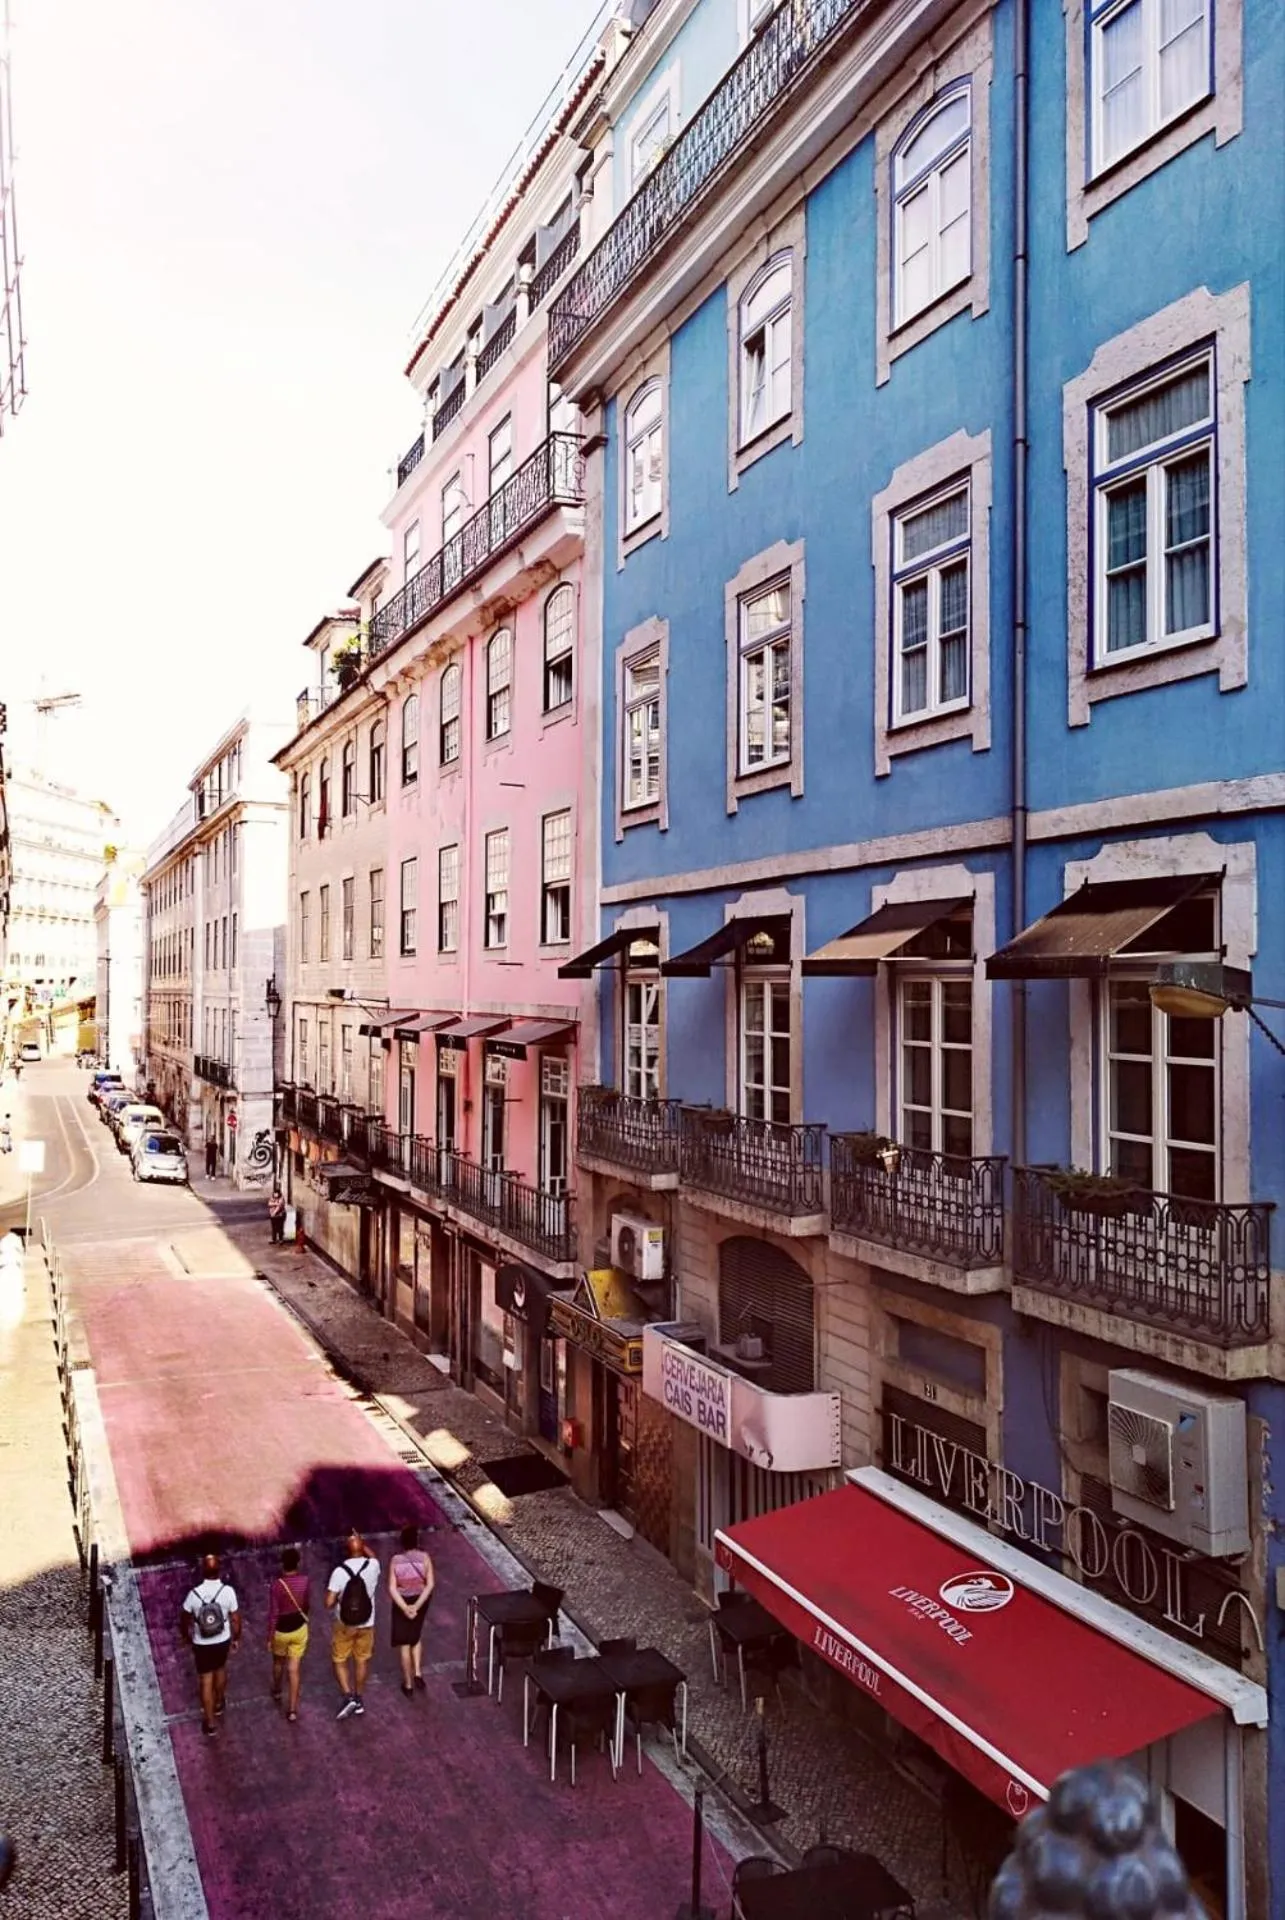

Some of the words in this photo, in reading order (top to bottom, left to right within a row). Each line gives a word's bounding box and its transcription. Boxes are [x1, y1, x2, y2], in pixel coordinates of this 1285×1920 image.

[664, 1351, 726, 1408] CERVEJARIA
[664, 1379, 692, 1416] CAIS
[698, 1399, 726, 1439] BAR
[889, 1412, 1205, 1638] LIVERPOOL
[888, 1586, 974, 1646] LIVERPOOL
[813, 1625, 882, 1697] LIVERPOOL
